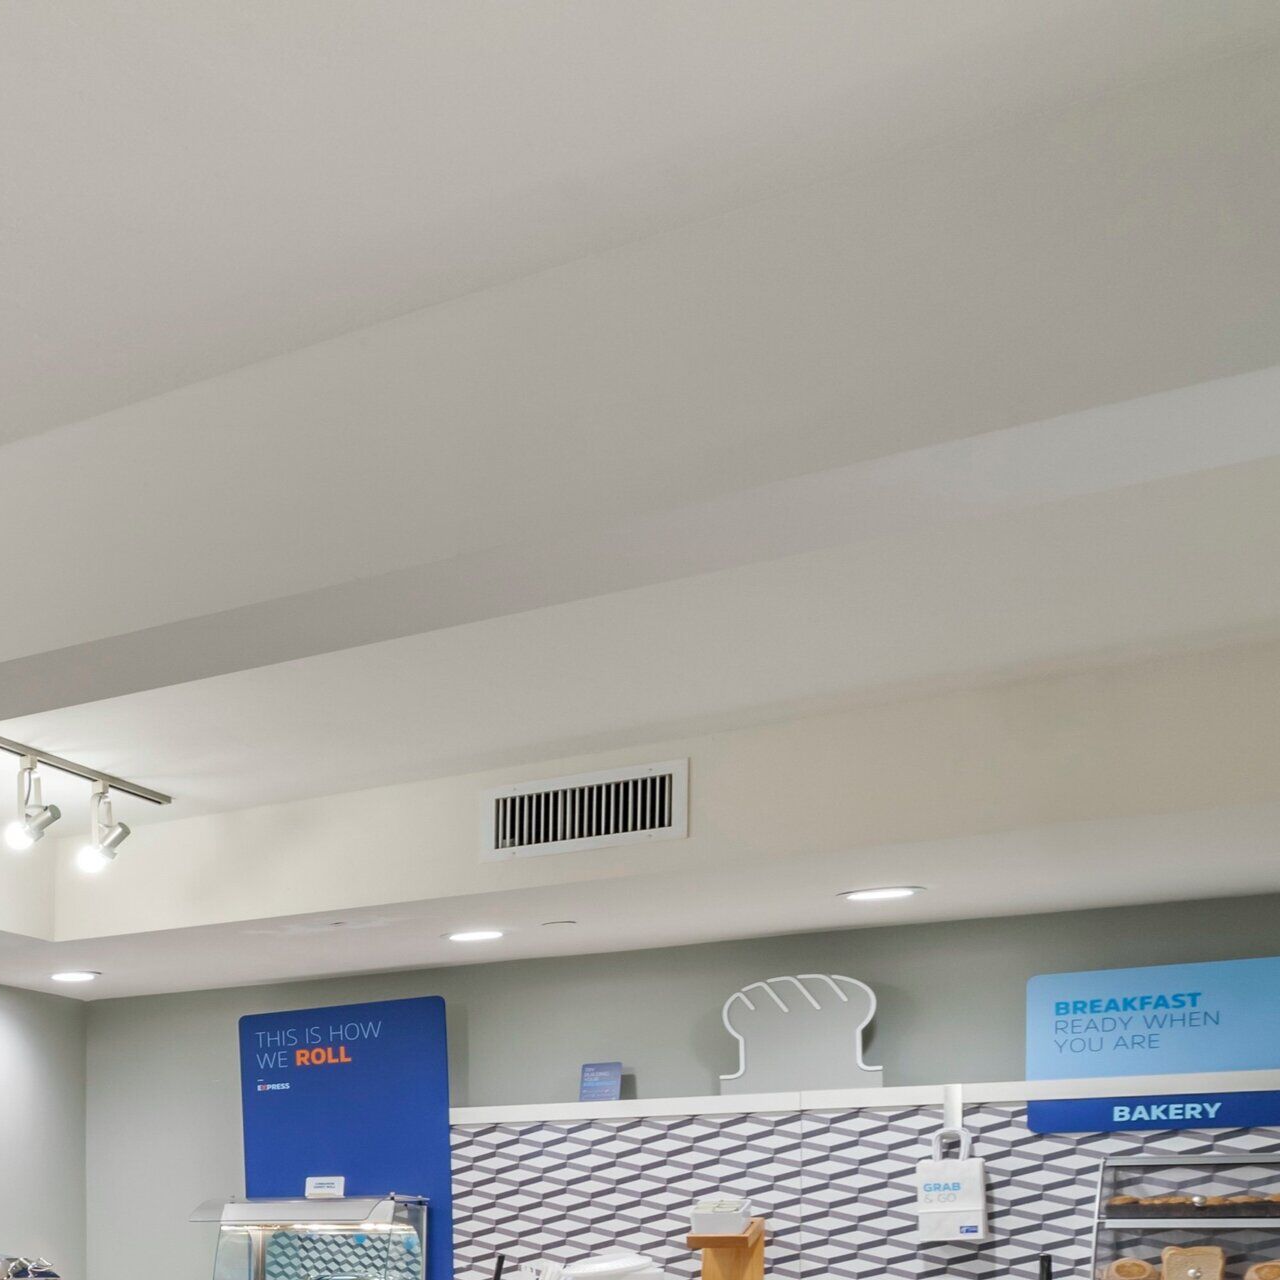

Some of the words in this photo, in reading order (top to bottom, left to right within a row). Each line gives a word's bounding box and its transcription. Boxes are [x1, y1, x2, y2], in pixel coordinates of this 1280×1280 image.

[1054, 992, 1202, 1016] BREAKFAST
[1054, 1015, 1133, 1035] READY
[1142, 1010, 1220, 1030] WHEN
[255, 1028, 298, 1049] THIS
[305, 1026, 322, 1044] IS
[329, 1020, 382, 1042] HOW
[1054, 1036, 1104, 1054] YOU
[1113, 1033, 1161, 1051] ARE
[256, 1050, 289, 1070] WE
[295, 1046, 353, 1067] ROLL
[257, 1082, 291, 1092] EXPRESS
[1112, 1102, 1222, 1122] BAKERY
[923, 1182, 961, 1192] GRAB
